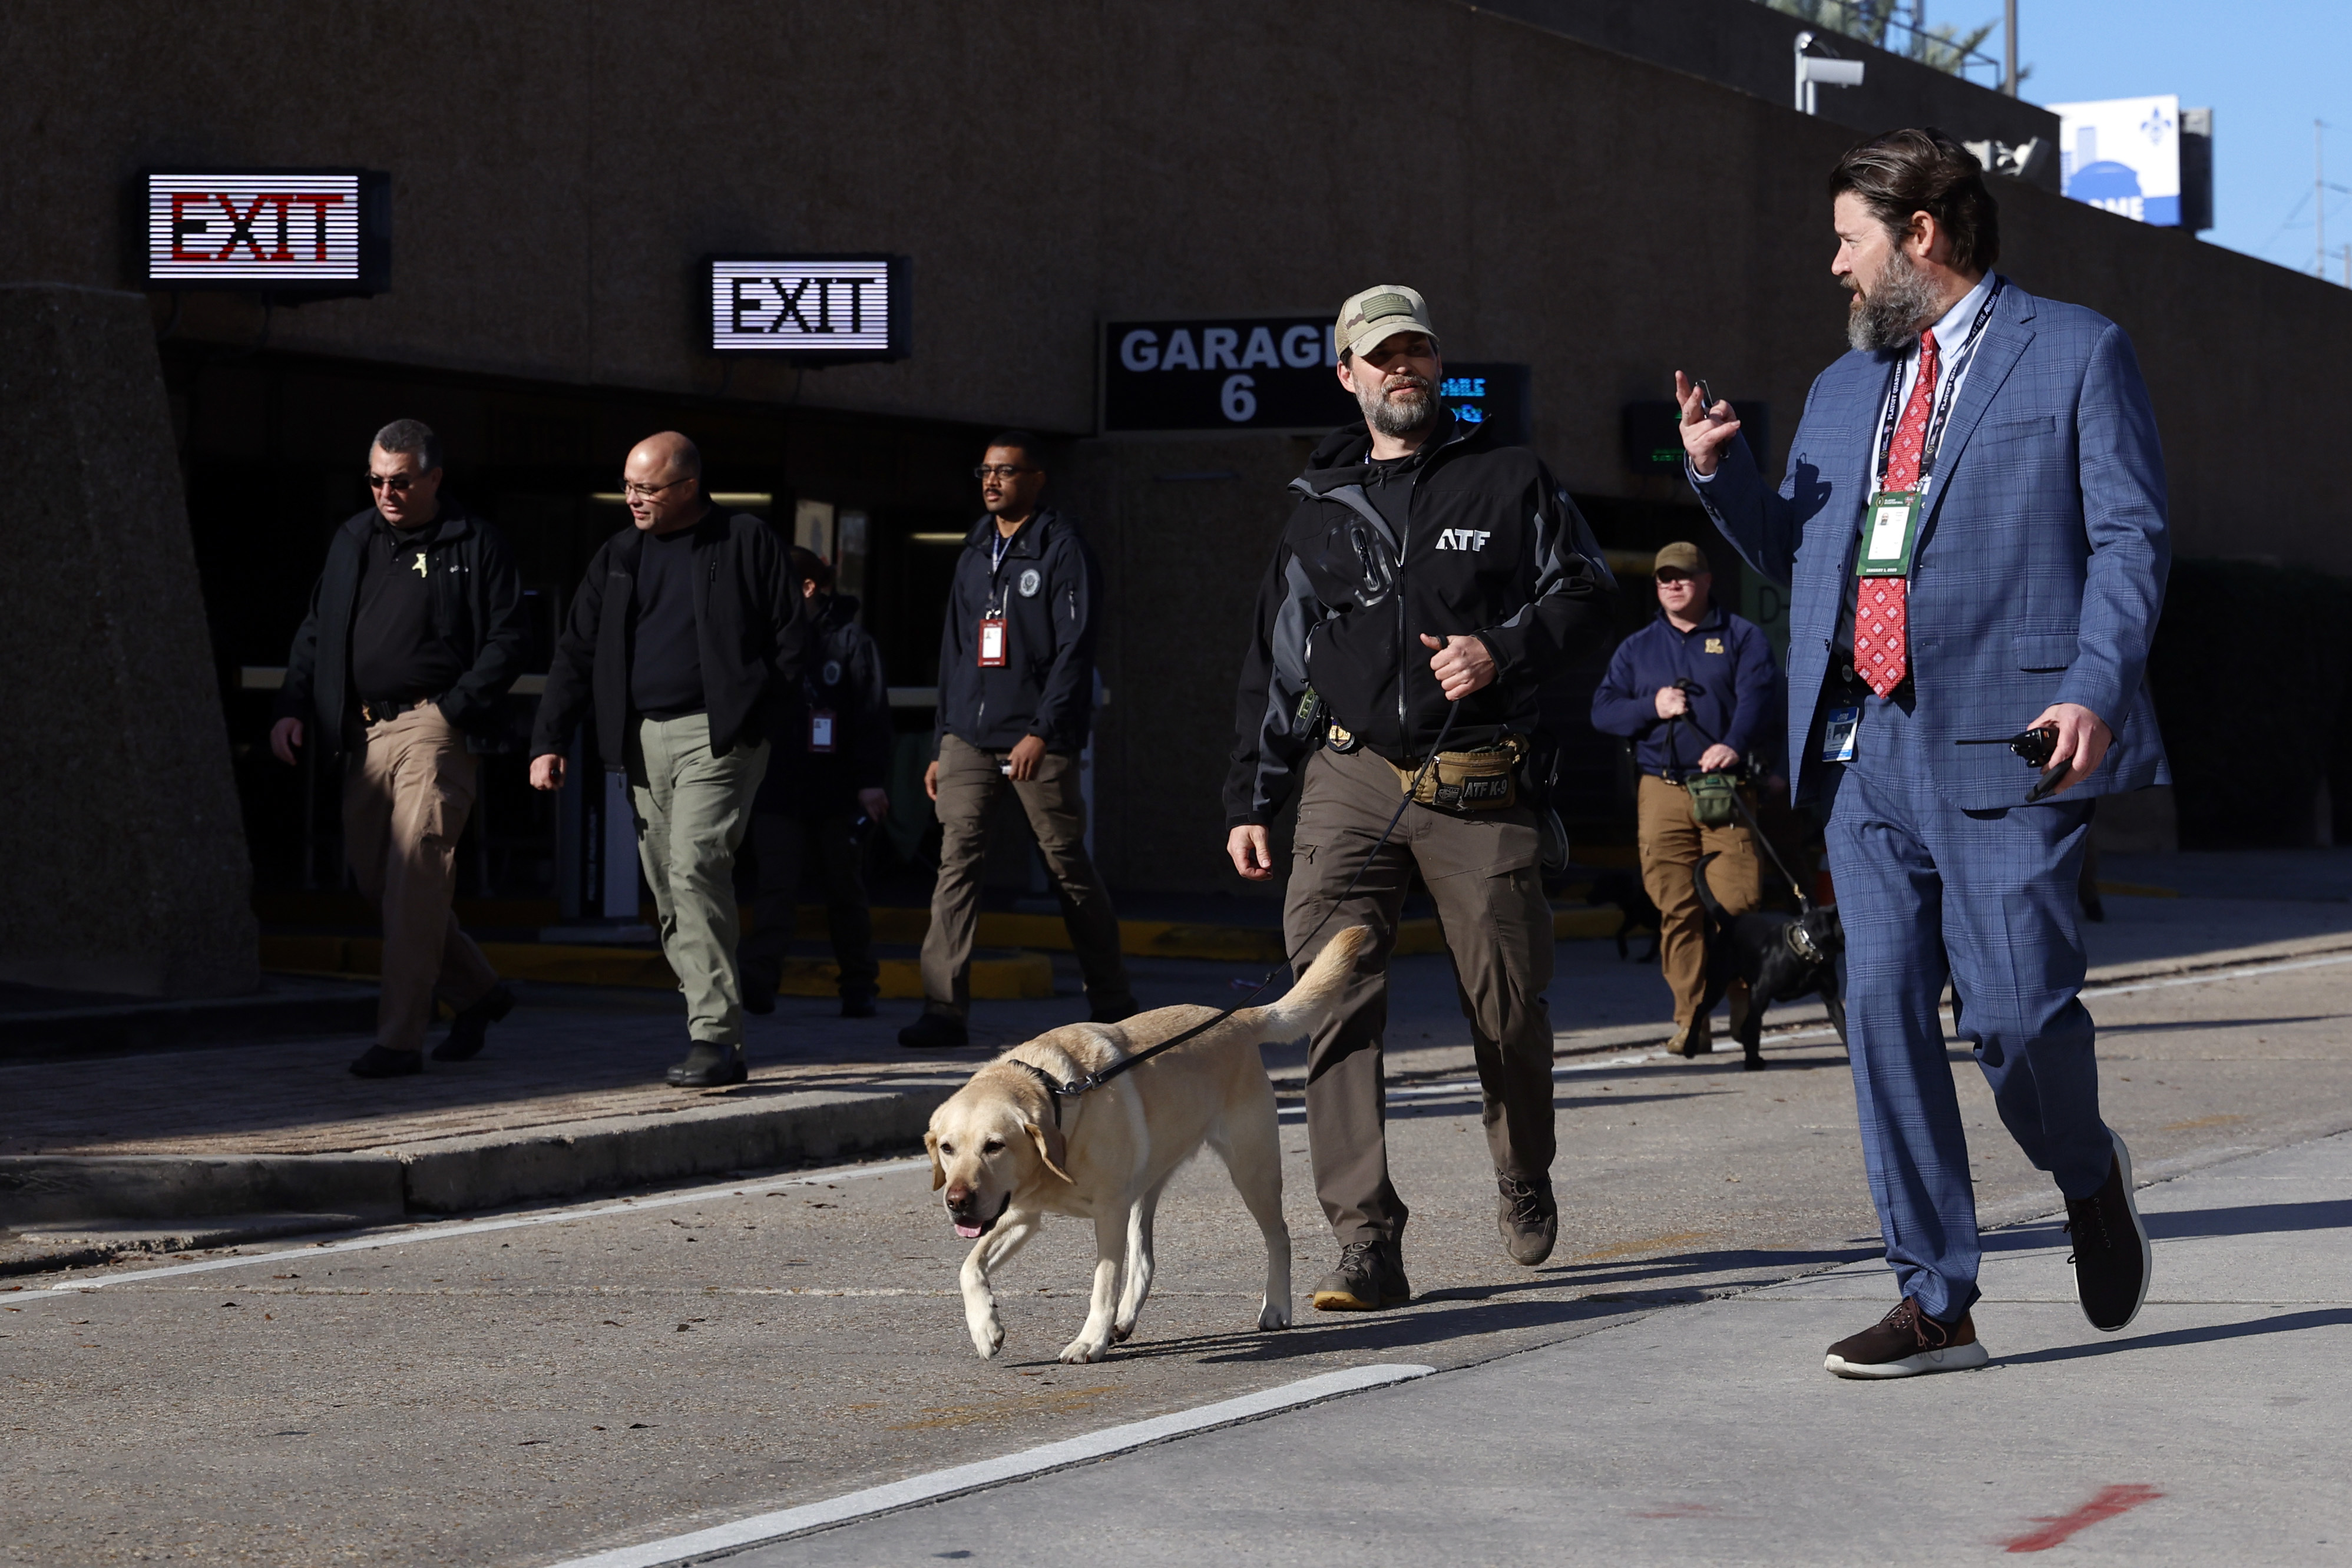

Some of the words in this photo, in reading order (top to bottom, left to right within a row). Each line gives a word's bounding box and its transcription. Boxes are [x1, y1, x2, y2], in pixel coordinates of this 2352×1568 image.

[2089, 196, 2145, 222] ME
[172, 193, 344, 261] EXIT
[732, 277, 875, 333] EXIT
[1976, 313, 1987, 327] THE
[1983, 293, 1998, 316] Allstate
[1220, 373, 1258, 423] 6
[1434, 528, 1491, 553] ATF
[1464, 782, 1488, 798] ATF
[1489, 779, 1508, 796] K-9
